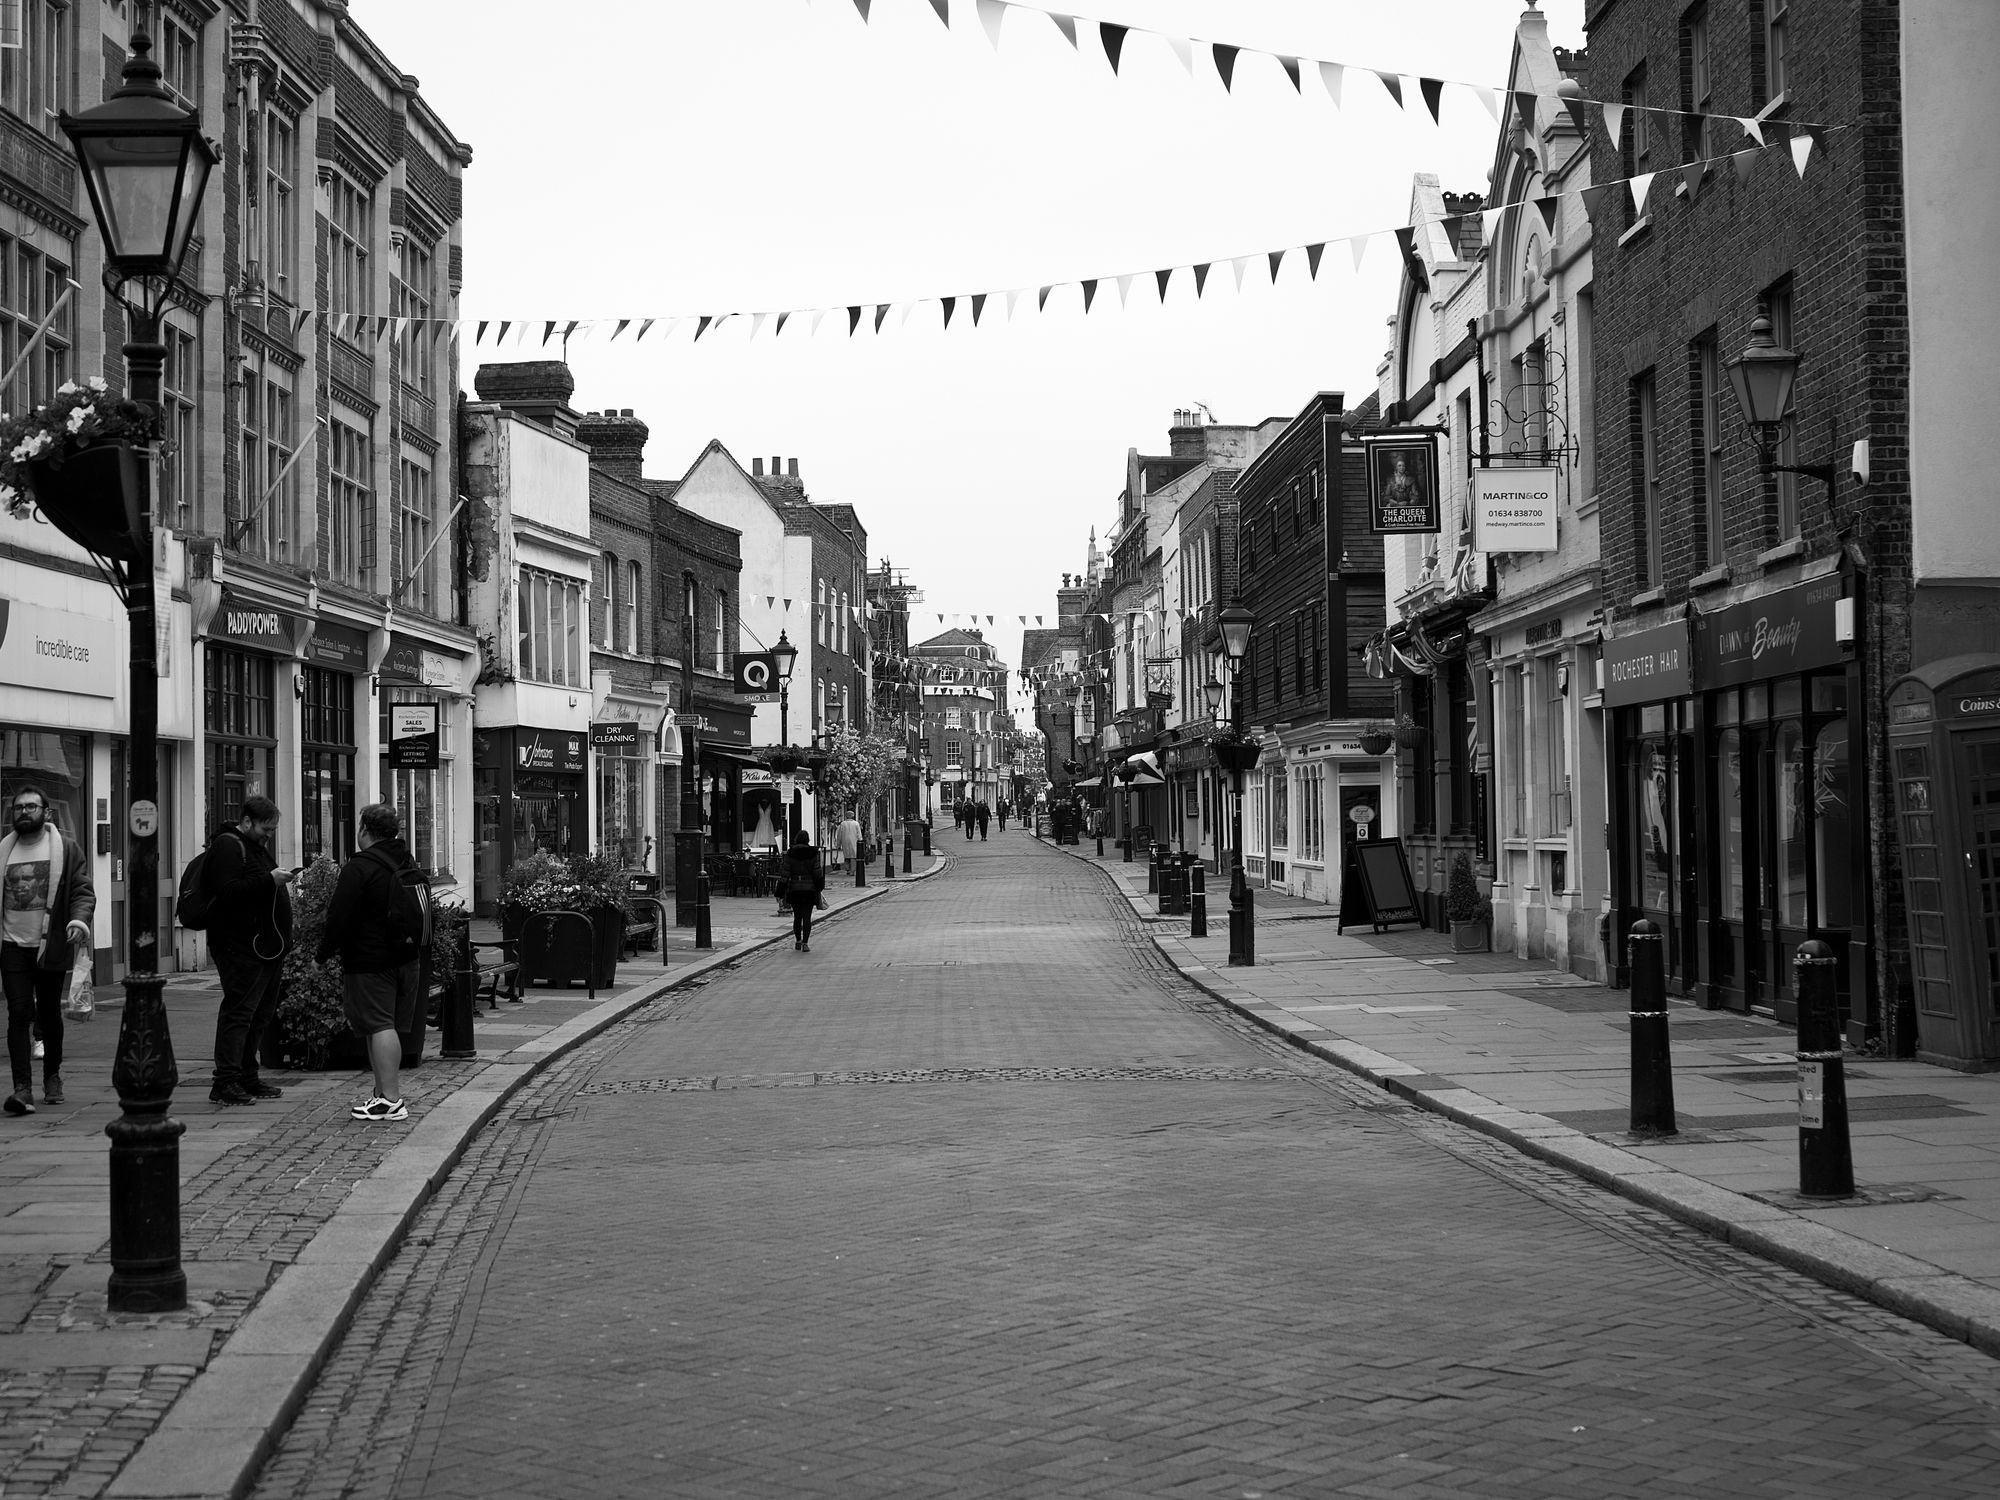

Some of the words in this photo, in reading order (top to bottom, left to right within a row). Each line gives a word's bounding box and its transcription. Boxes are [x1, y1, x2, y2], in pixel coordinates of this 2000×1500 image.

[1483, 492, 1548, 500] MARTIN&CO
[1399, 508, 1426, 516] QUEEN
[1382, 514, 1427, 523] CHARLOTTE
[227, 611, 279, 635] PADDYPOWER
[1719, 630, 1742, 655] DAWN
[1751, 616, 1801, 660] Beauty
[36, 635, 73, 660] incredible
[73, 646, 89, 663] care
[1612, 654, 1654, 683] ROCHESTER
[1659, 649, 1679, 673] HAIR
[606, 726, 622, 734] DRY
[594, 734, 635, 743] CLEANING
[523, 733, 554, 768] Johnsons
[742, 771, 760, 781] Kiss
[1801, 1115, 1819, 1124] time
